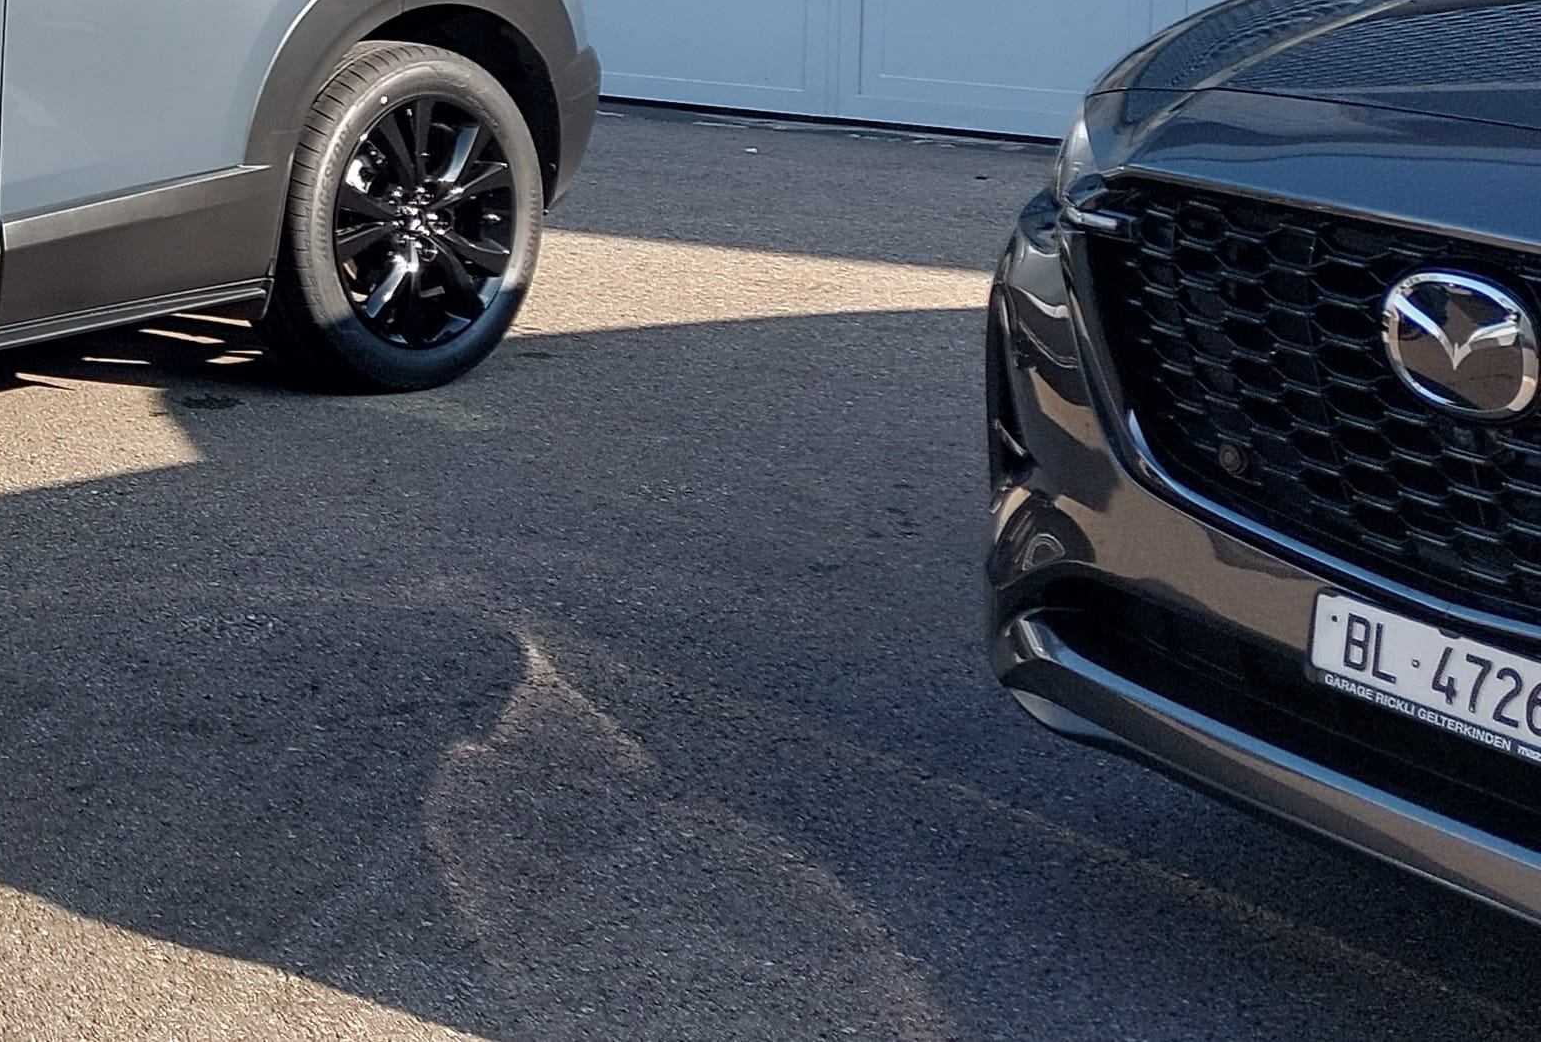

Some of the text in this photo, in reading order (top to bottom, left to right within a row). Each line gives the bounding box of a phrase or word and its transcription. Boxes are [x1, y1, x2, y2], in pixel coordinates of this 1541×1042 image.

[1343, 613, 1397, 684] BL
[1324, 674, 1375, 701] GARAGE
[1375, 693, 1415, 715] RICKLI
[1417, 710, 1512, 751] GELTERKINDEN
